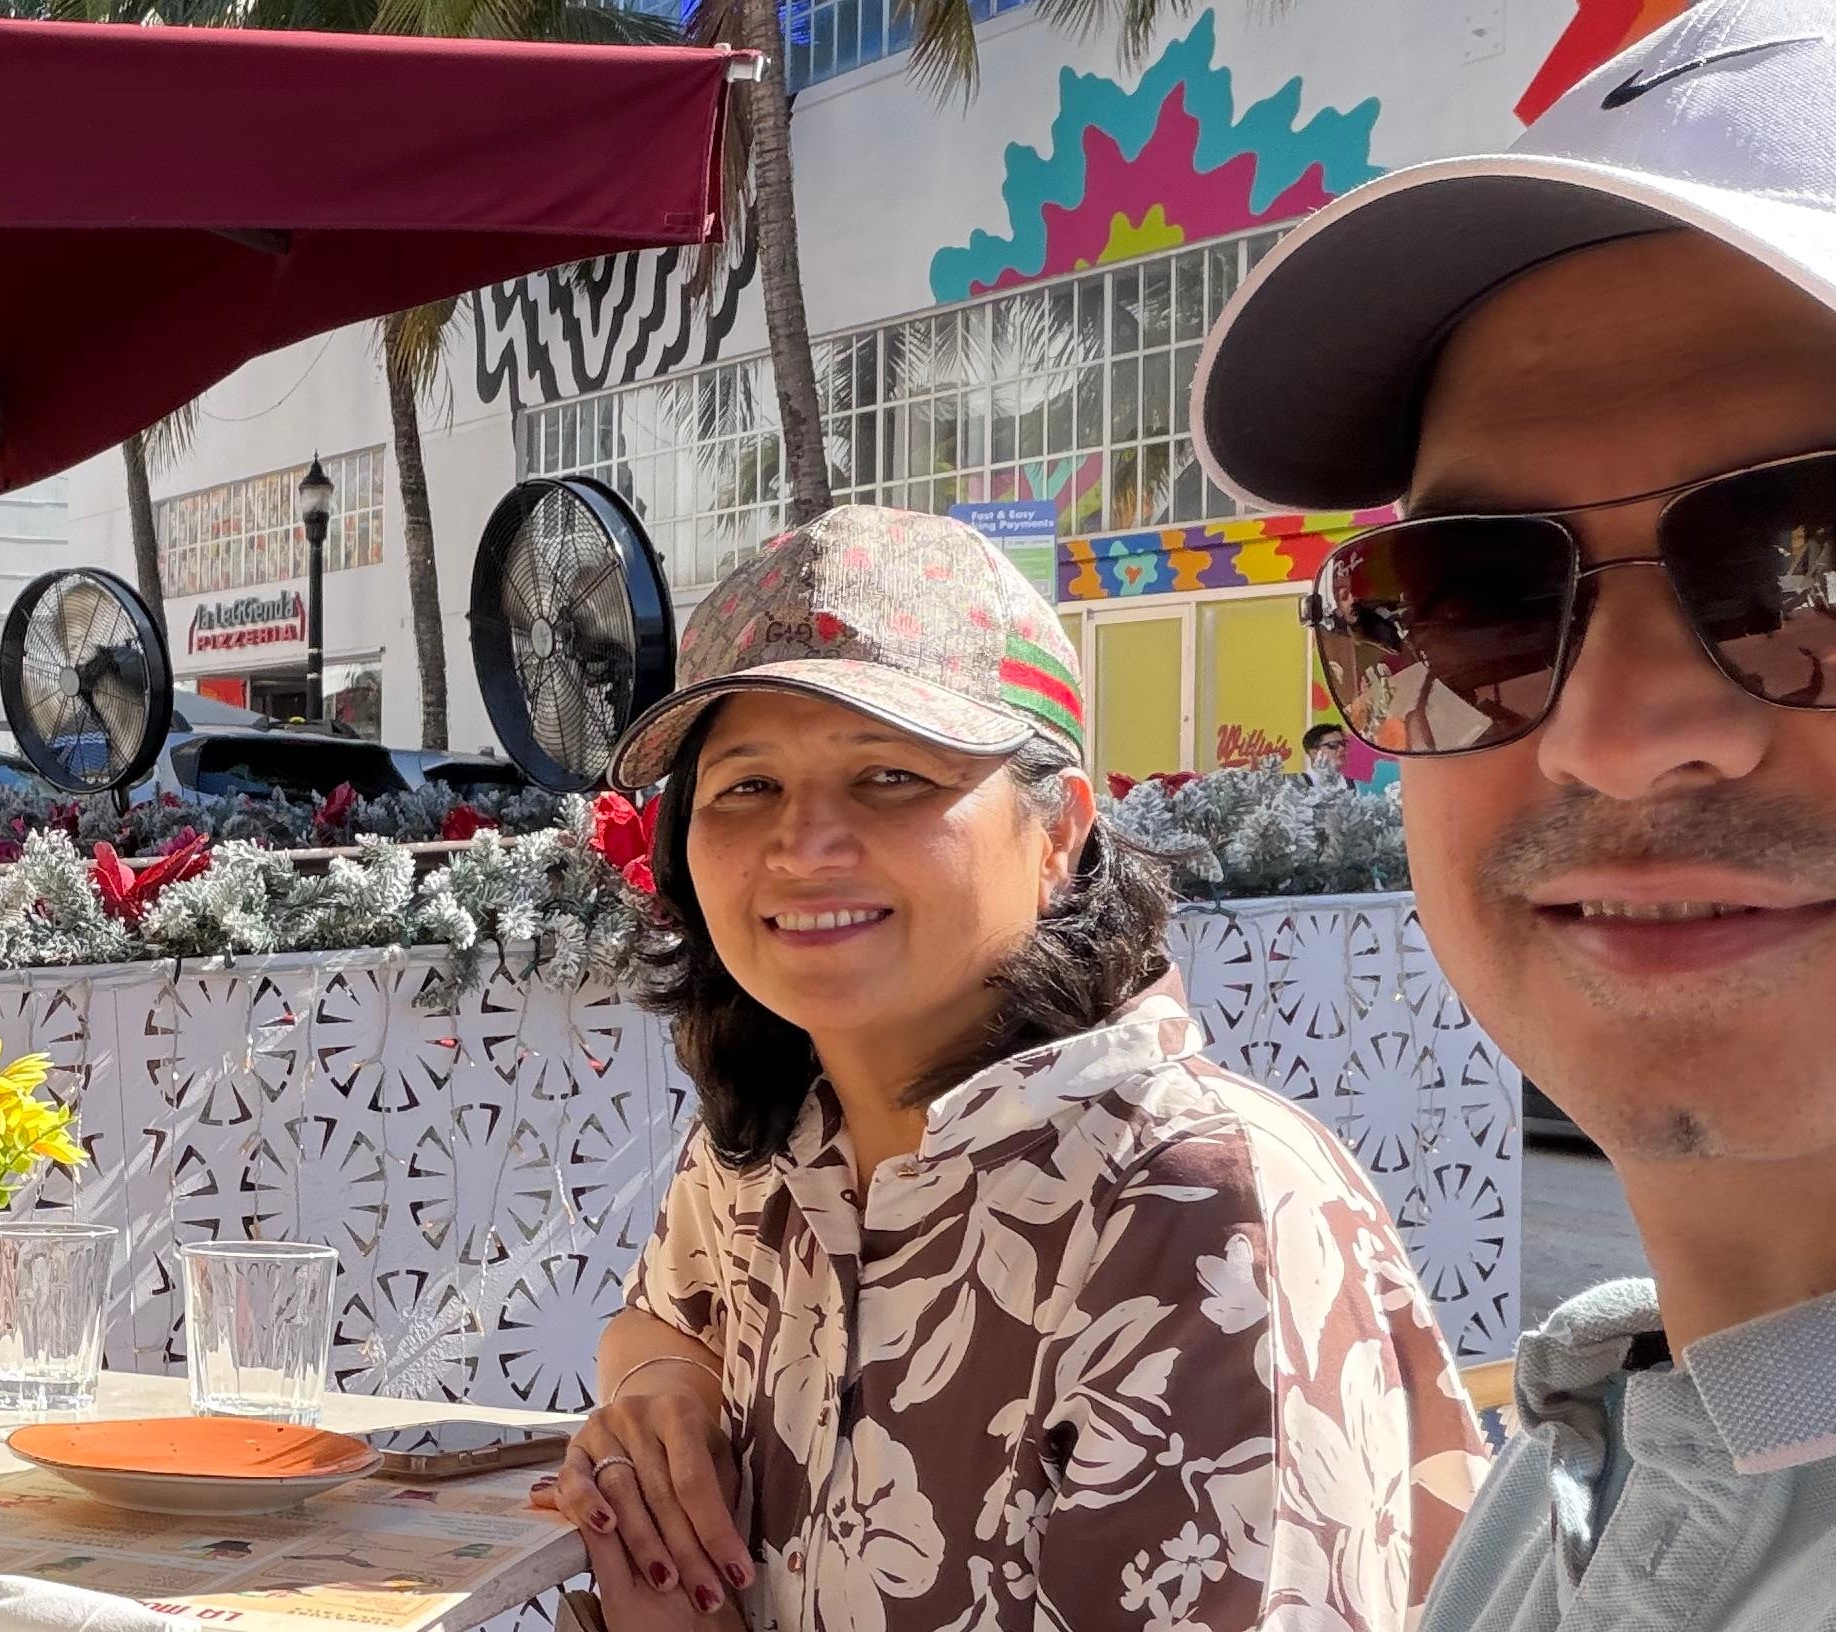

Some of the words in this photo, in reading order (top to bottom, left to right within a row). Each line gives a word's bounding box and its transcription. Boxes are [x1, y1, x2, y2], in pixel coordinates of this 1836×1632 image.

[997, 510, 1005, 519] &
[999, 519, 1055, 531] Payments
[196, 624, 298, 652] PIZZERIA
[196, 1609, 243, 1622] LA
